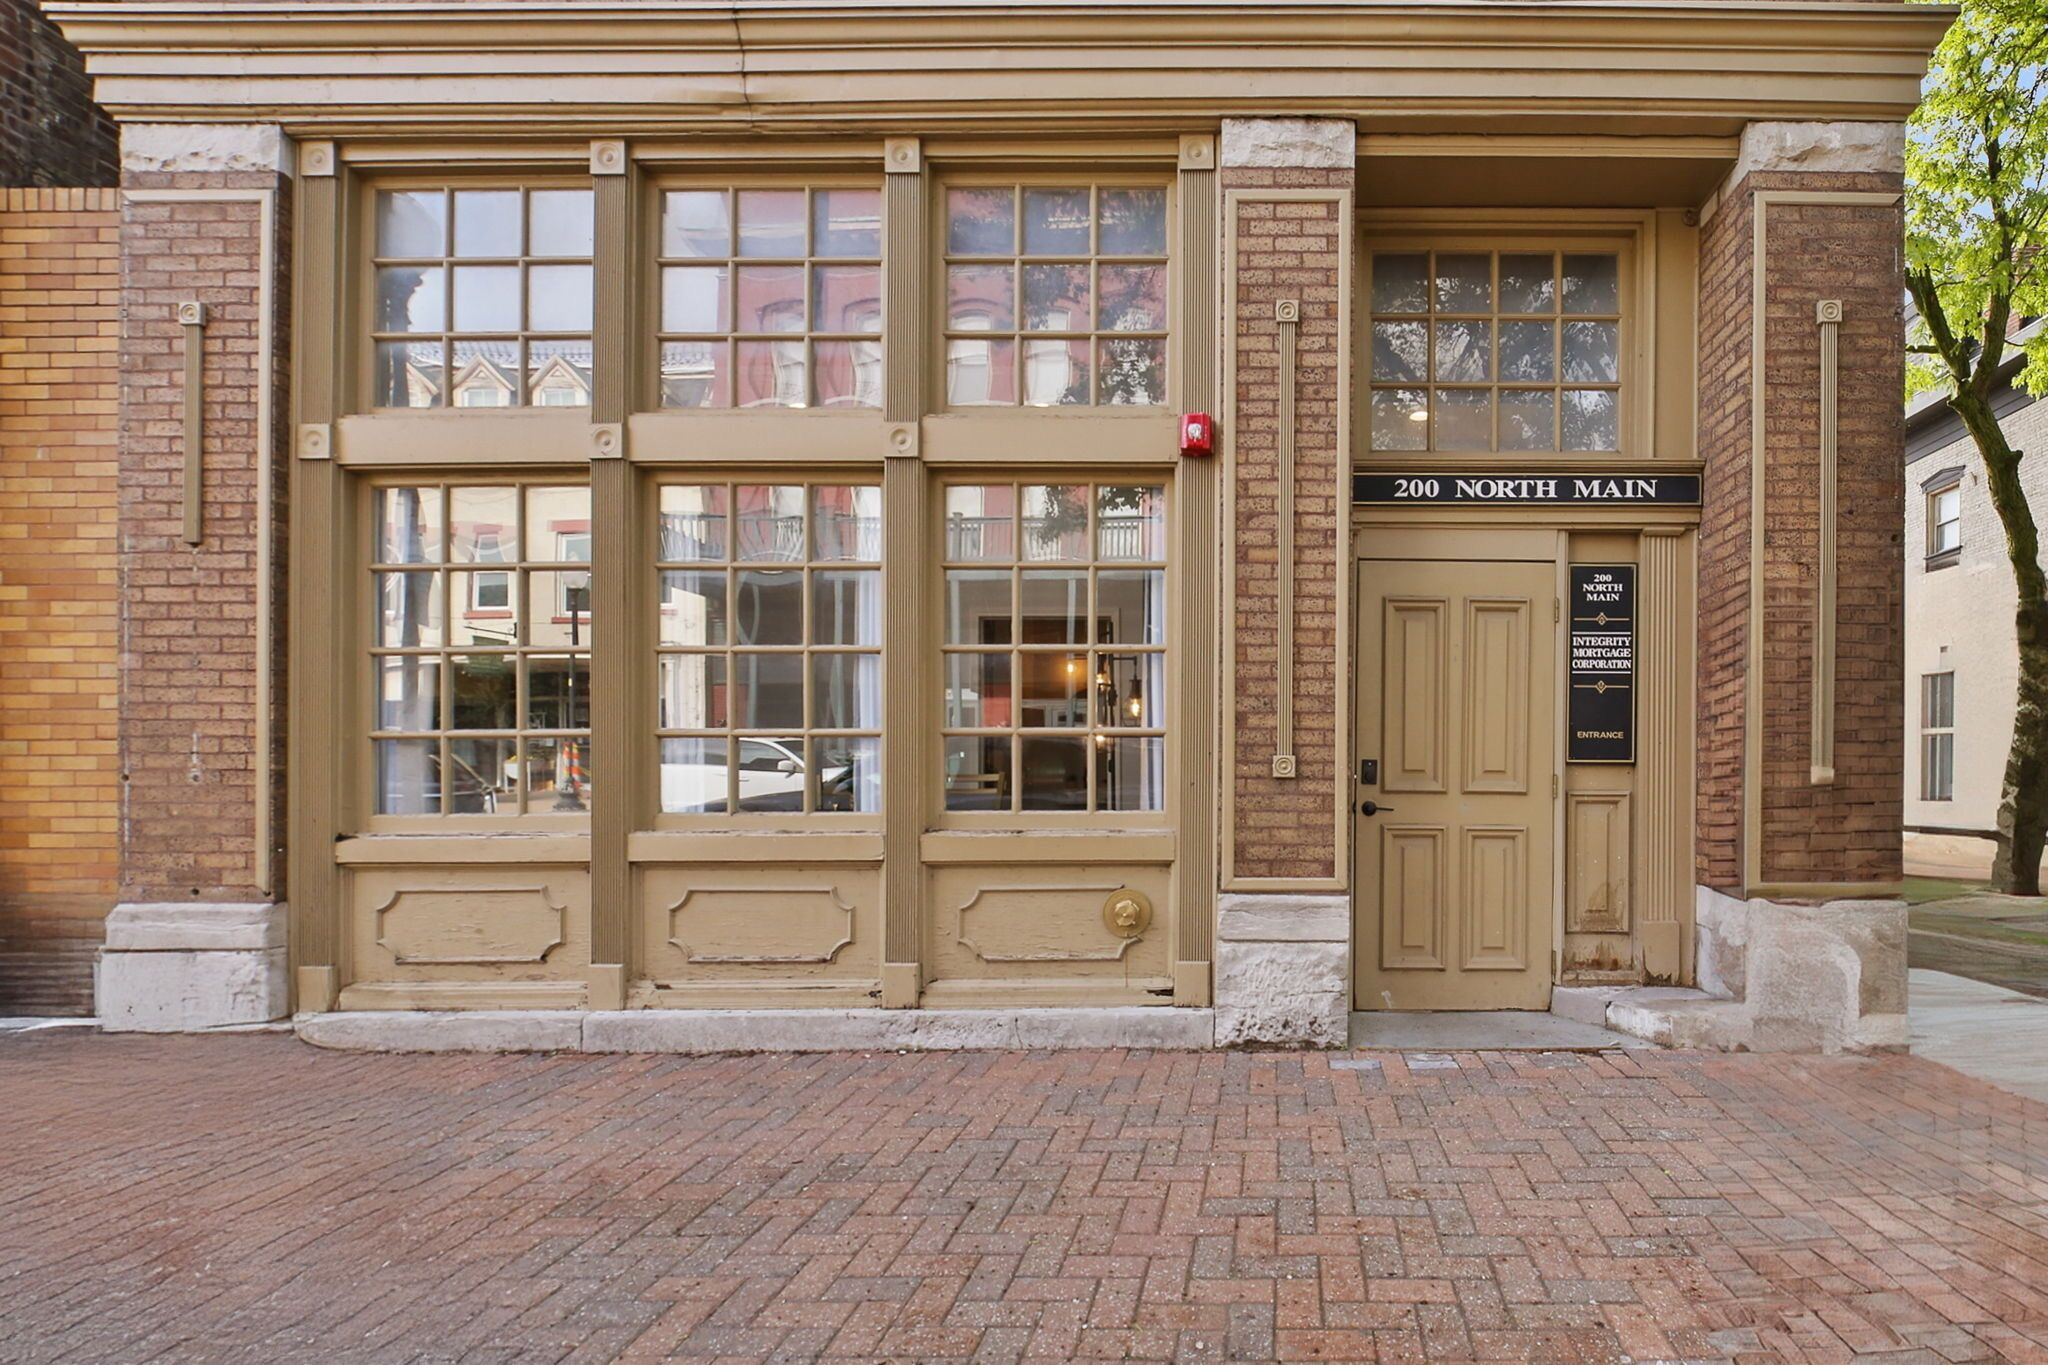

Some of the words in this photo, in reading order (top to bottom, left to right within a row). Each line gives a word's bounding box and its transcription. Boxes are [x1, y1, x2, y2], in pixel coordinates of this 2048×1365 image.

[1394, 479, 1440, 498] 200
[1455, 479, 1557, 498] NORTH
[1573, 479, 1658, 498] MAIN
[1593, 574, 1612, 582] 200
[1583, 583, 1623, 592] NORTH
[1586, 593, 1620, 601] MAIN
[1573, 637, 1631, 646] INTEGRITY
[1573, 648, 1631, 657] MORTGAGE
[1572, 659, 1631, 668] CORPORATION
[1577, 731, 1624, 739] ENTRANCE
